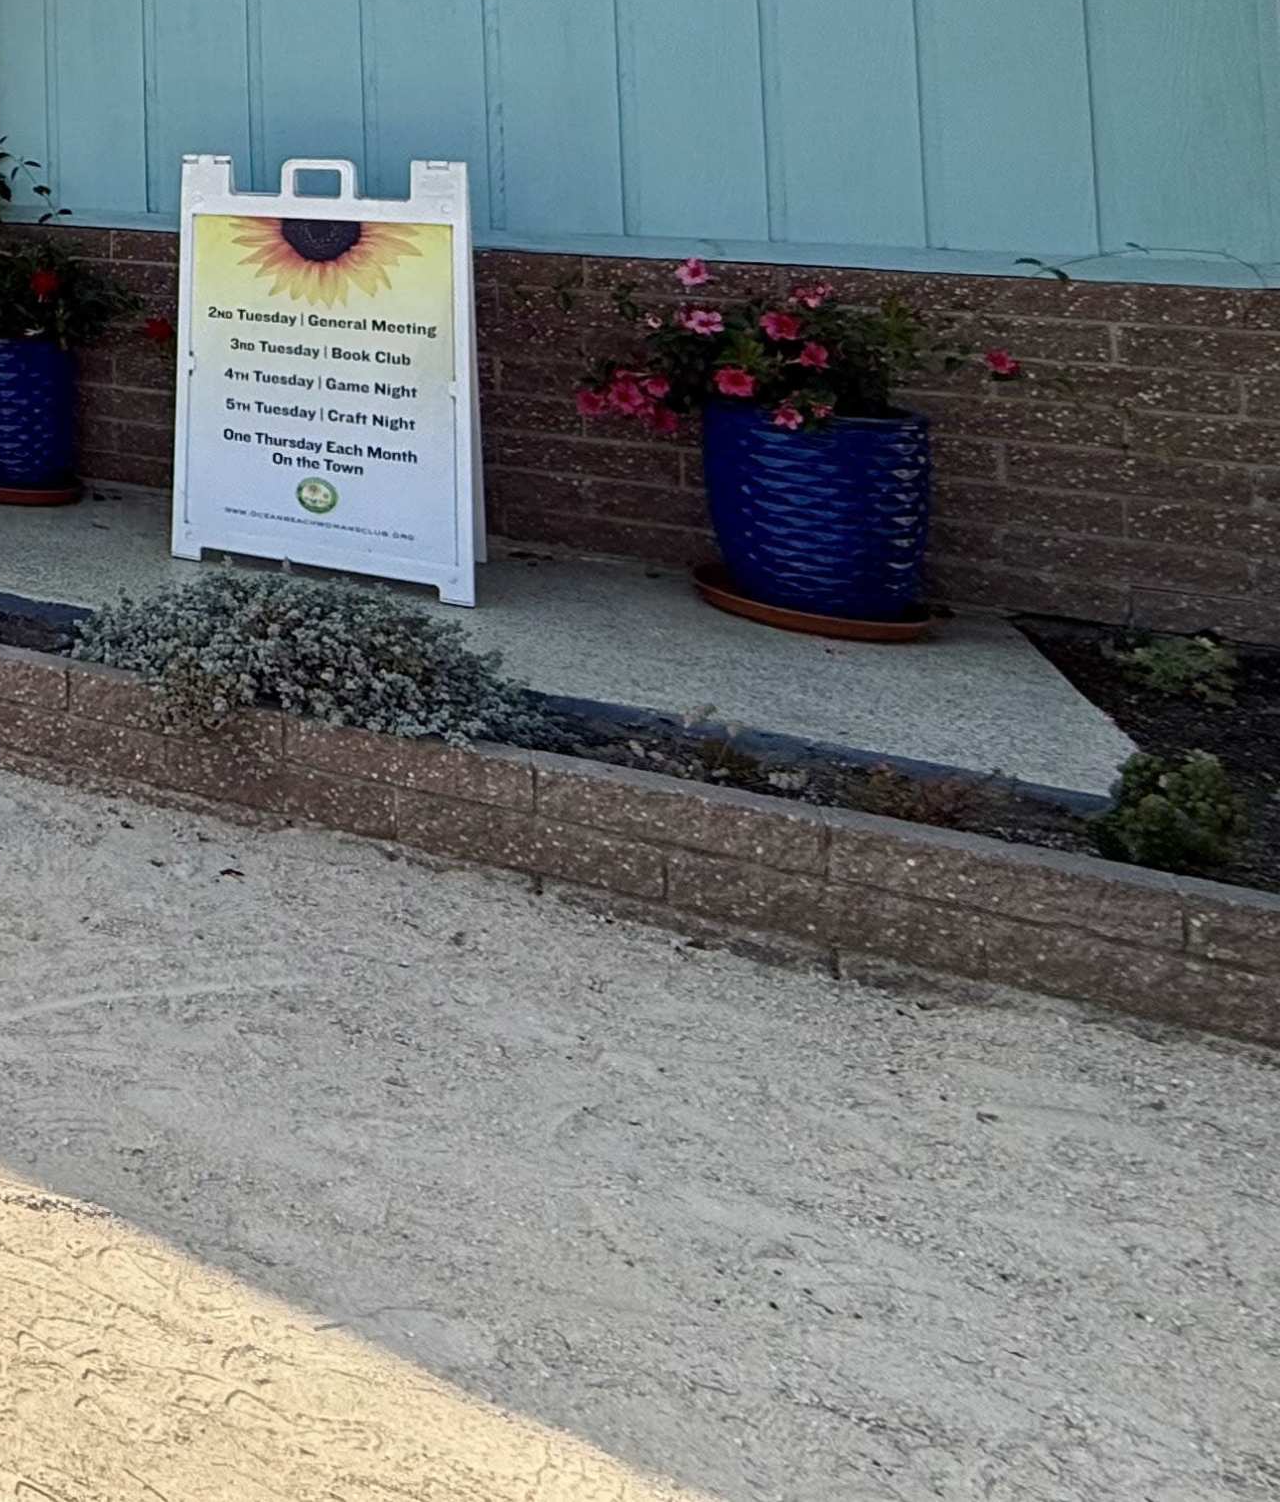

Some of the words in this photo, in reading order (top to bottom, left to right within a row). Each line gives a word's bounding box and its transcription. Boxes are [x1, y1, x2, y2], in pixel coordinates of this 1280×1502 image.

[208, 306, 232, 319] 2ND
[237, 309, 297, 327] Tuesday
[308, 314, 367, 330] General
[371, 319, 437, 338] Meeting
[259, 341, 320, 359] Tuesday
[332, 347, 371, 362] Book
[375, 352, 411, 366] Club
[224, 368, 248, 381] 4TH
[253, 370, 314, 390] Tuesday
[326, 378, 369, 393] Game
[374, 383, 417, 399] Night
[226, 398, 250, 411] 5TH
[255, 401, 316, 421] Tuesday
[328, 409, 368, 425] Craft
[372, 414, 415, 431] Night
[223, 428, 251, 443] One
[255, 433, 322, 454] Thursday
[326, 441, 362, 456] Each
[367, 446, 418, 463] Month
[272, 452, 292, 466] On
[296, 457, 320, 469] the
[323, 459, 363, 475] Town
